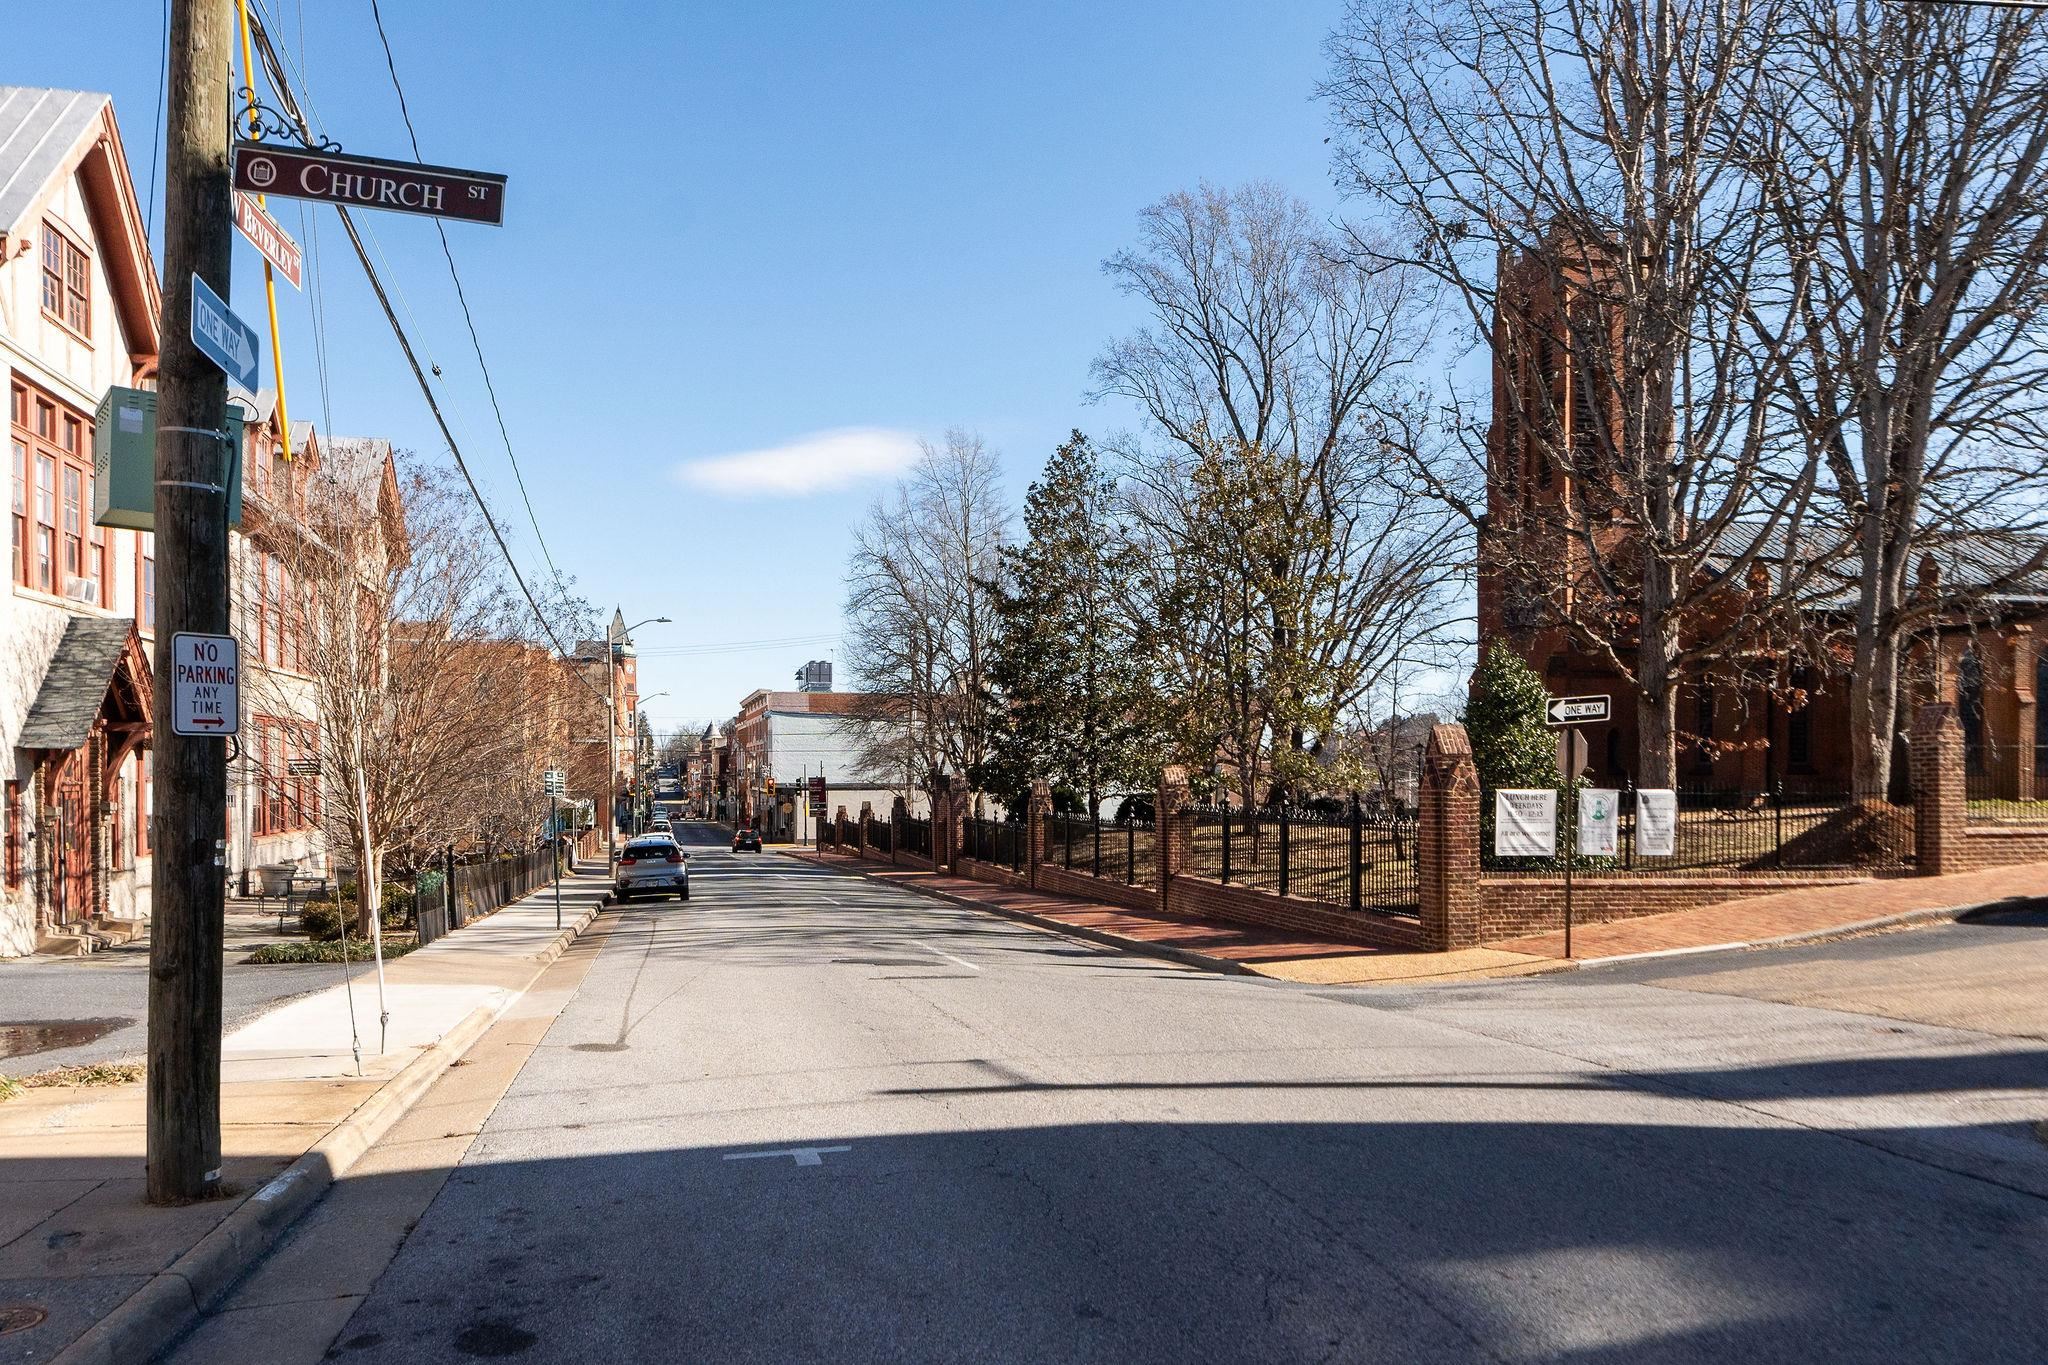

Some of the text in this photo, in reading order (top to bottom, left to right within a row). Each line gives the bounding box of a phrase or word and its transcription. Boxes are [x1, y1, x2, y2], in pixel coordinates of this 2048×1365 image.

[300, 164, 489, 211] CHURCH ST
[243, 200, 293, 275] BEVERLEY
[293, 254, 301, 270] ST
[200, 304, 241, 360] ONE WAY
[194, 643, 218, 662] NO
[178, 665, 234, 685] PARKING
[194, 686, 219, 699] ANY
[192, 701, 222, 714] TIME
[1565, 703, 1602, 715] ONE WAY
[1531, 793, 1548, 801] HERE
